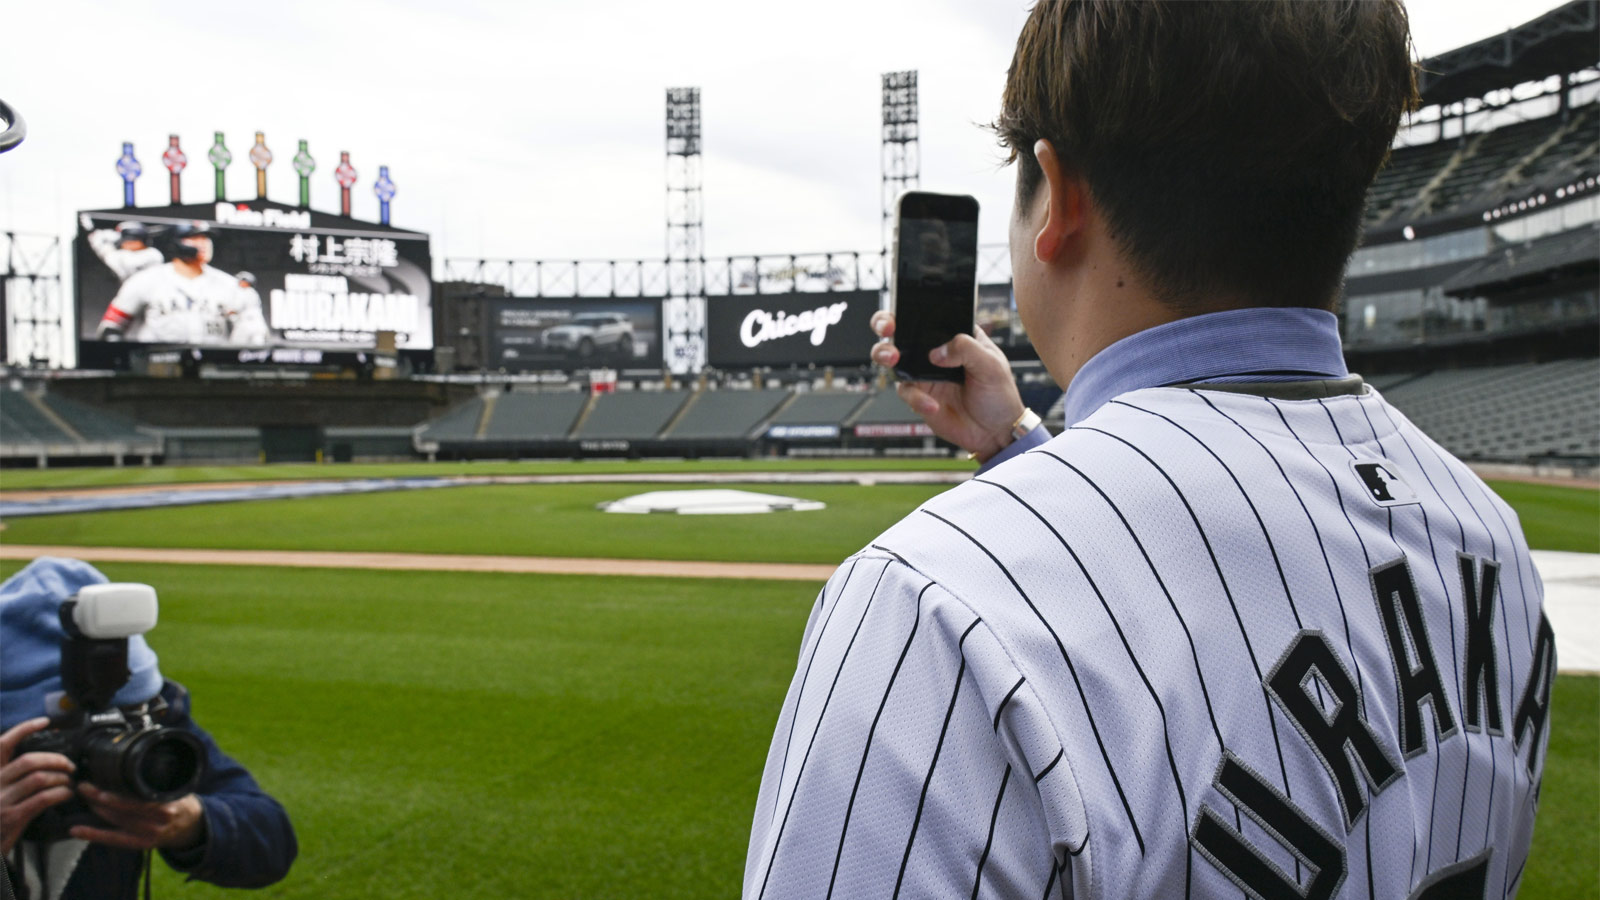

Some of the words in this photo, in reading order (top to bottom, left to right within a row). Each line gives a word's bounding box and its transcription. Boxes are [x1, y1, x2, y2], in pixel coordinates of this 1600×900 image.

[289, 233, 399, 267] 村上宗隆
[270, 289, 418, 331] MURAKAMI
[740, 301, 848, 348] Chicago
[1189, 551, 1557, 900] URAKA
